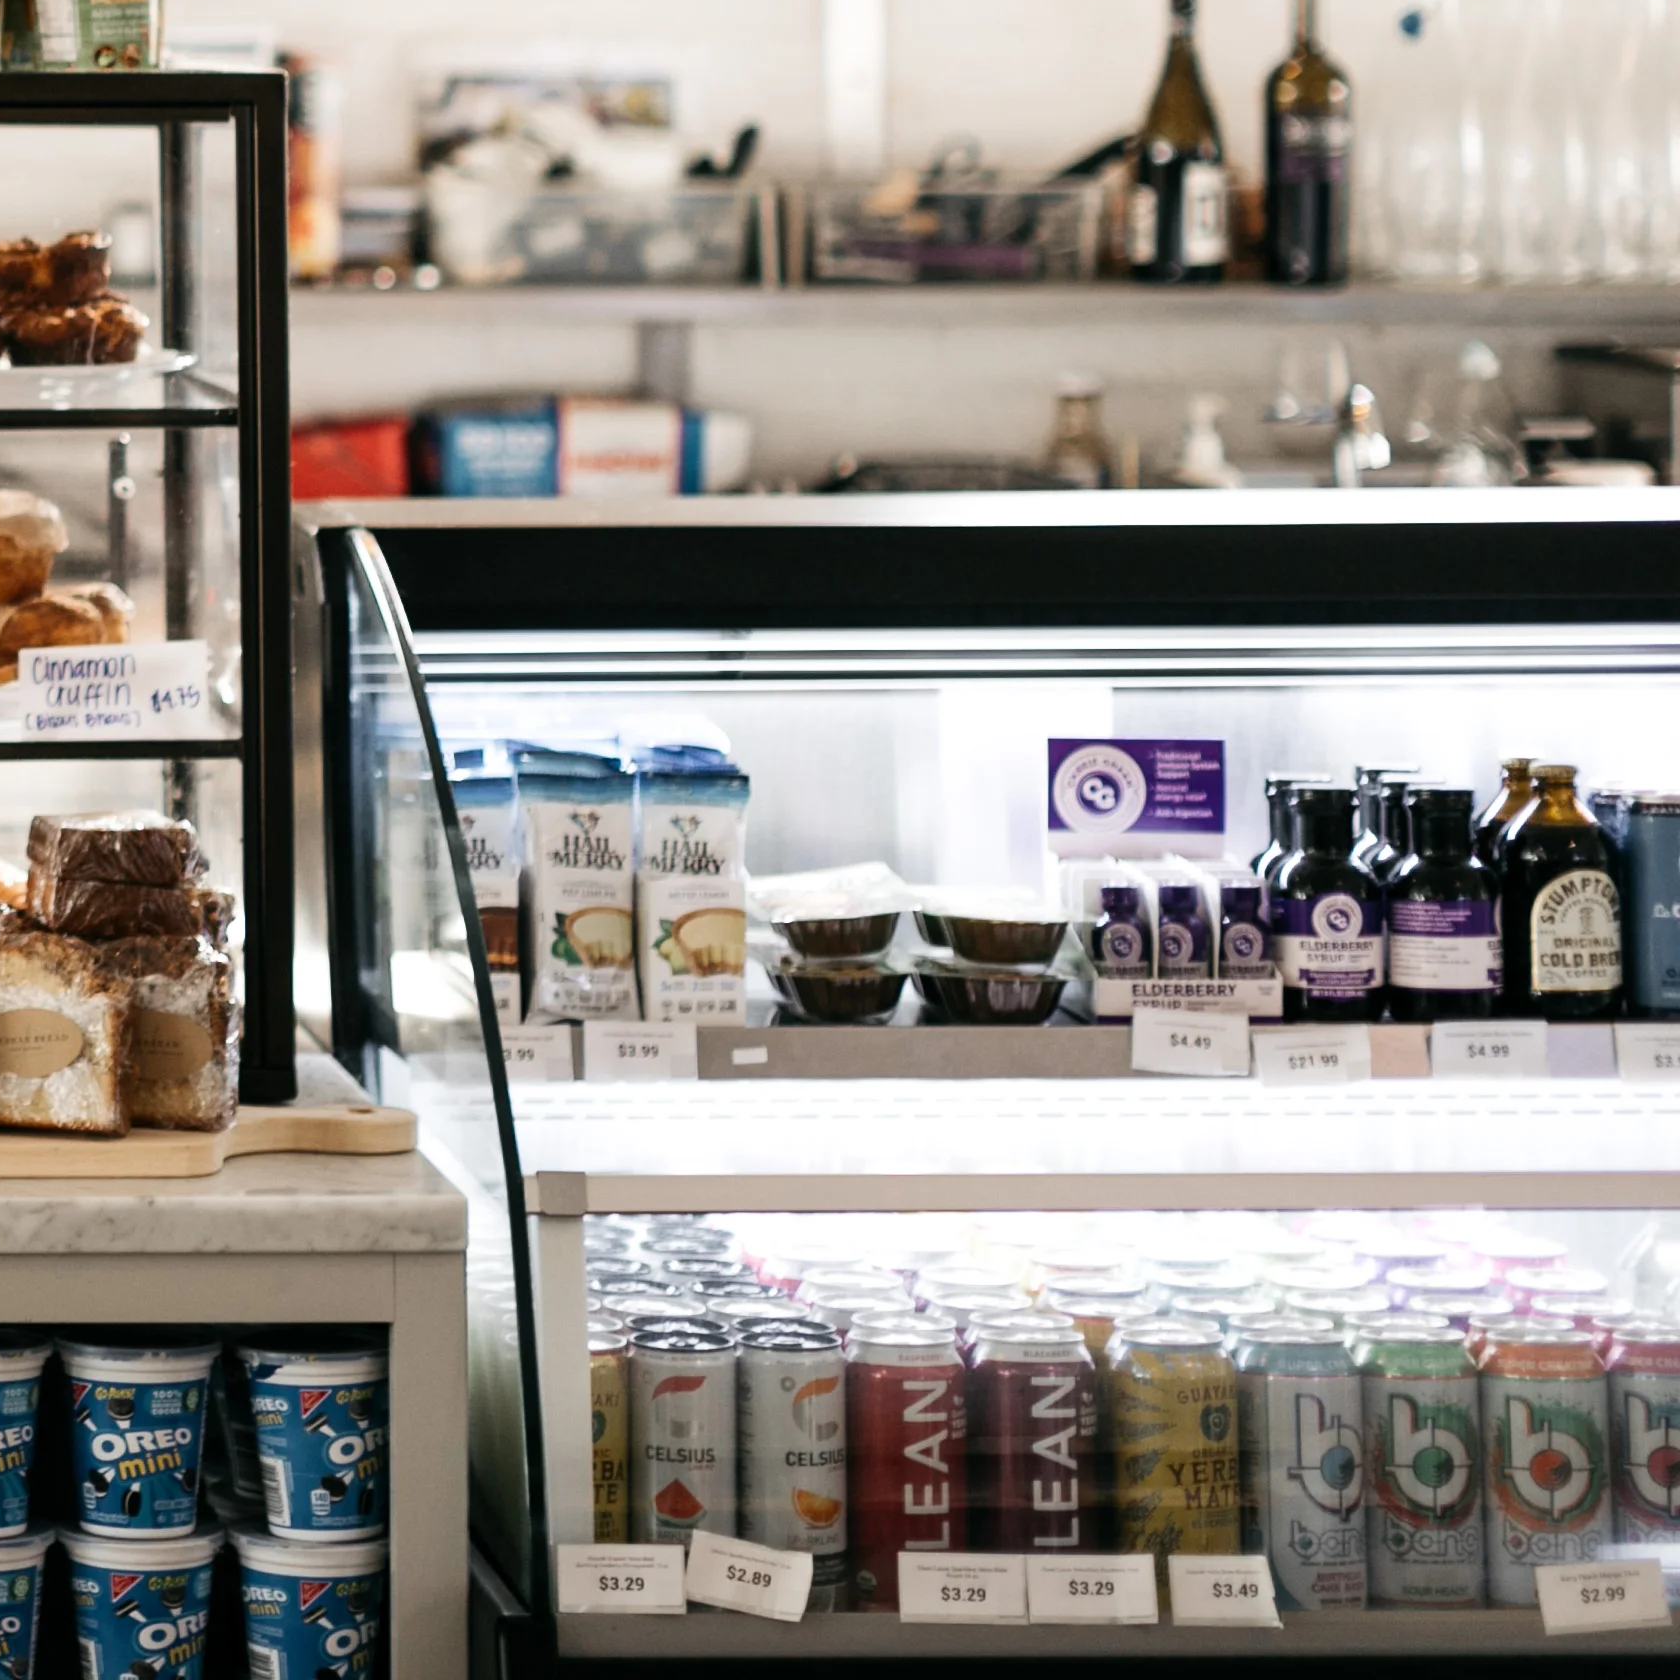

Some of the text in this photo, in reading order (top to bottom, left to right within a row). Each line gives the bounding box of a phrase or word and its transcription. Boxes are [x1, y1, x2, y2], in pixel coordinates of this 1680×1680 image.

[33, 655, 136, 684] Cinnamon
[563, 835, 615, 854] HAIL
[663, 839, 713, 857] HAIL
[549, 850, 626, 870] MERRY
[647, 856, 725, 875] MERRY
[1300, 941, 1373, 952] ELDERBERRY
[1554, 938, 1616, 948] ORIGINAL
[1307, 954, 1344, 962] SYRUP
[1541, 953, 1584, 967] COLD
[1132, 984, 1236, 998] ELDERBERRY
[1170, 1034, 1211, 1048] $4.49
[618, 1043, 658, 1058] $3.99
[1468, 1045, 1510, 1057] $4.99
[1289, 1055, 1338, 1069] $21.99
[153, 1390, 182, 1399] 100%
[92, 1428, 192, 1461] OREO
[646, 1445, 715, 1463] CELSIUS
[786, 1449, 844, 1467] CELSIUS
[119, 1448, 182, 1480] mini
[1385, 1513, 1478, 1558] bang
[600, 1576, 644, 1591] $3.29
[727, 1566, 771, 1588] $2.89
[941, 1587, 986, 1602] $3.29
[1070, 1580, 1114, 1596] $3.29
[1212, 1583, 1259, 1598] $3.49
[1581, 1587, 1624, 1603] $2.99
